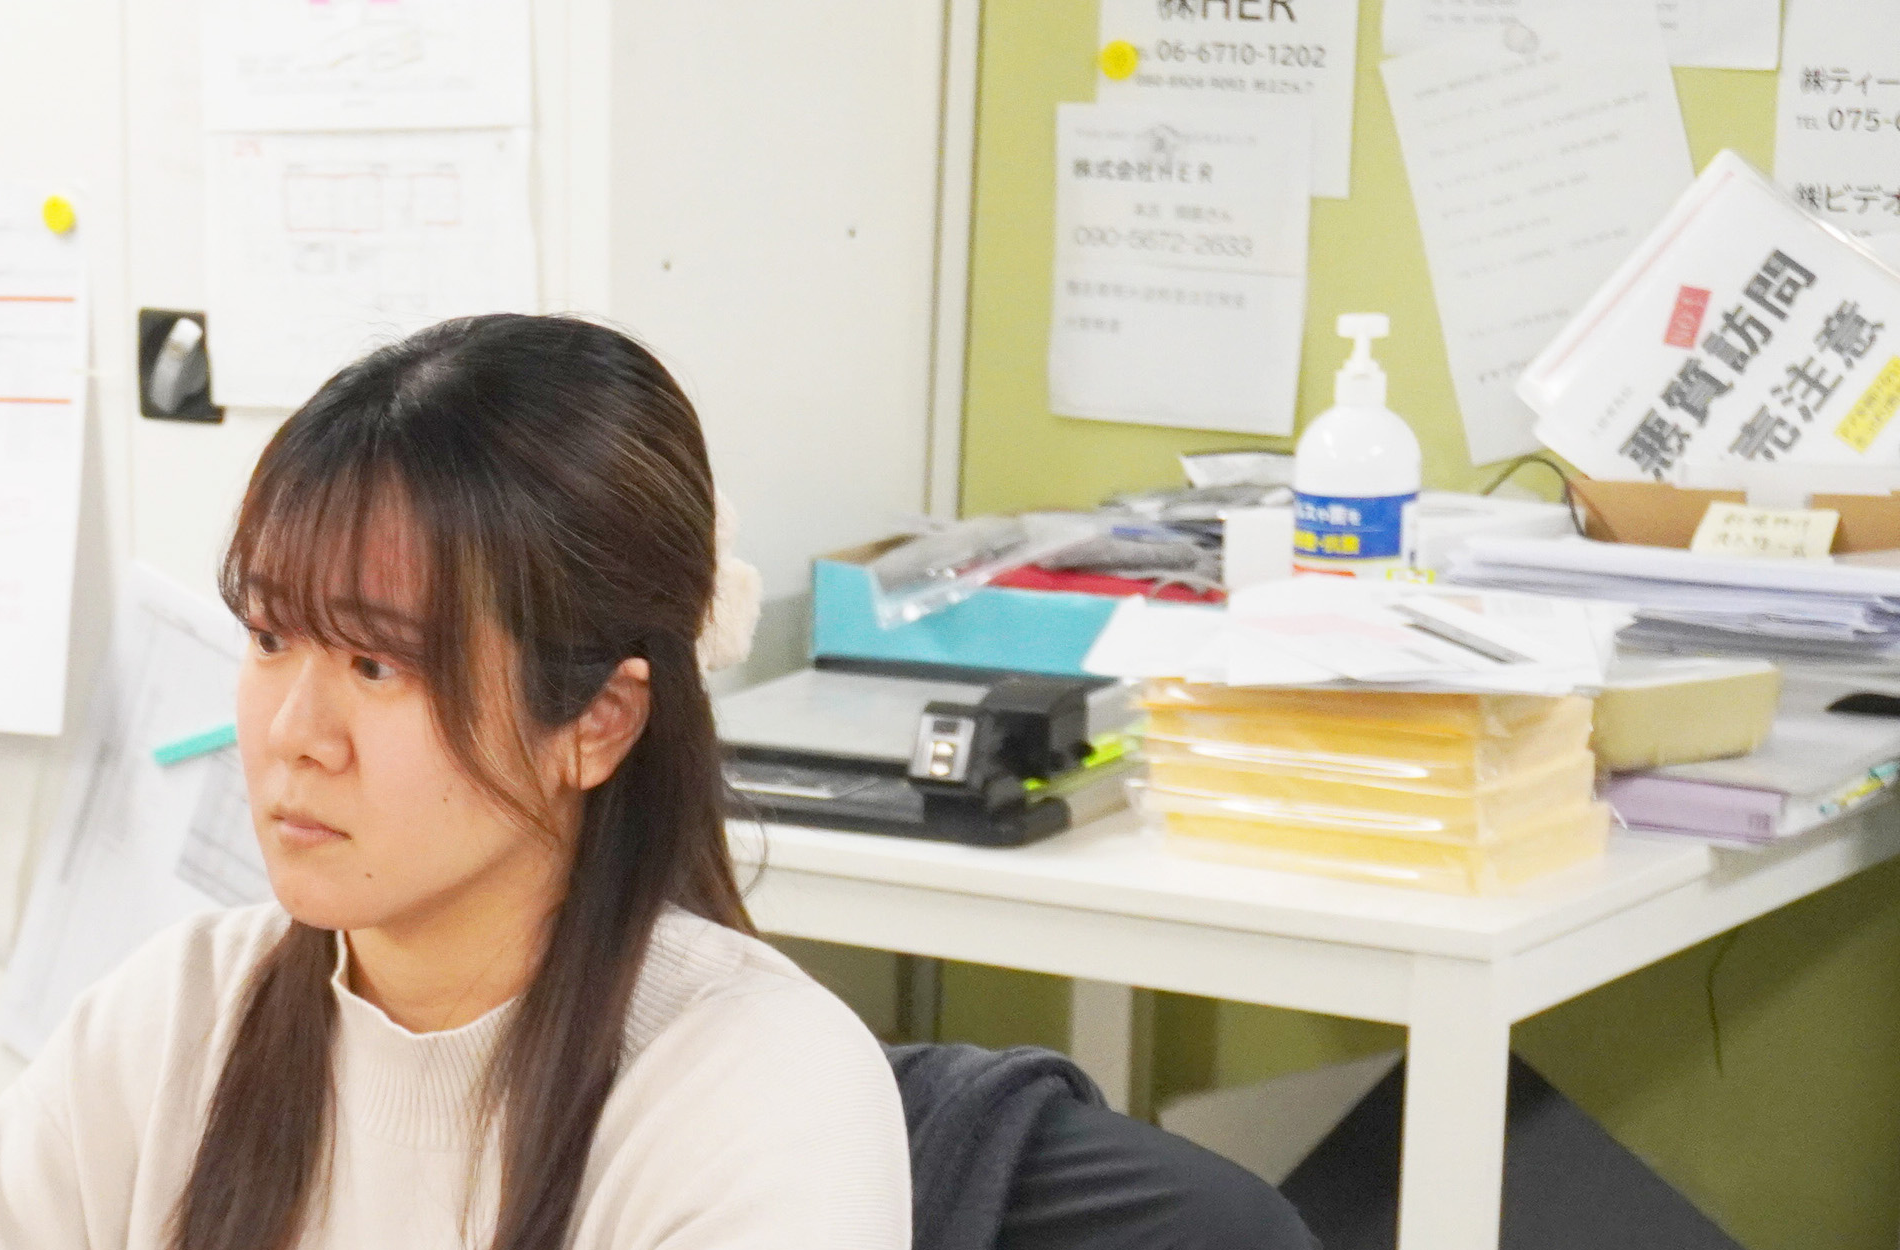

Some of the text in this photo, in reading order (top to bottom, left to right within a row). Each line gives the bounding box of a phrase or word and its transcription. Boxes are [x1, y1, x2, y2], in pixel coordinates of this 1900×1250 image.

[1156, 39, 1327, 68] 06-6710-1202
[1618, 248, 1818, 481] 悪質訪問
